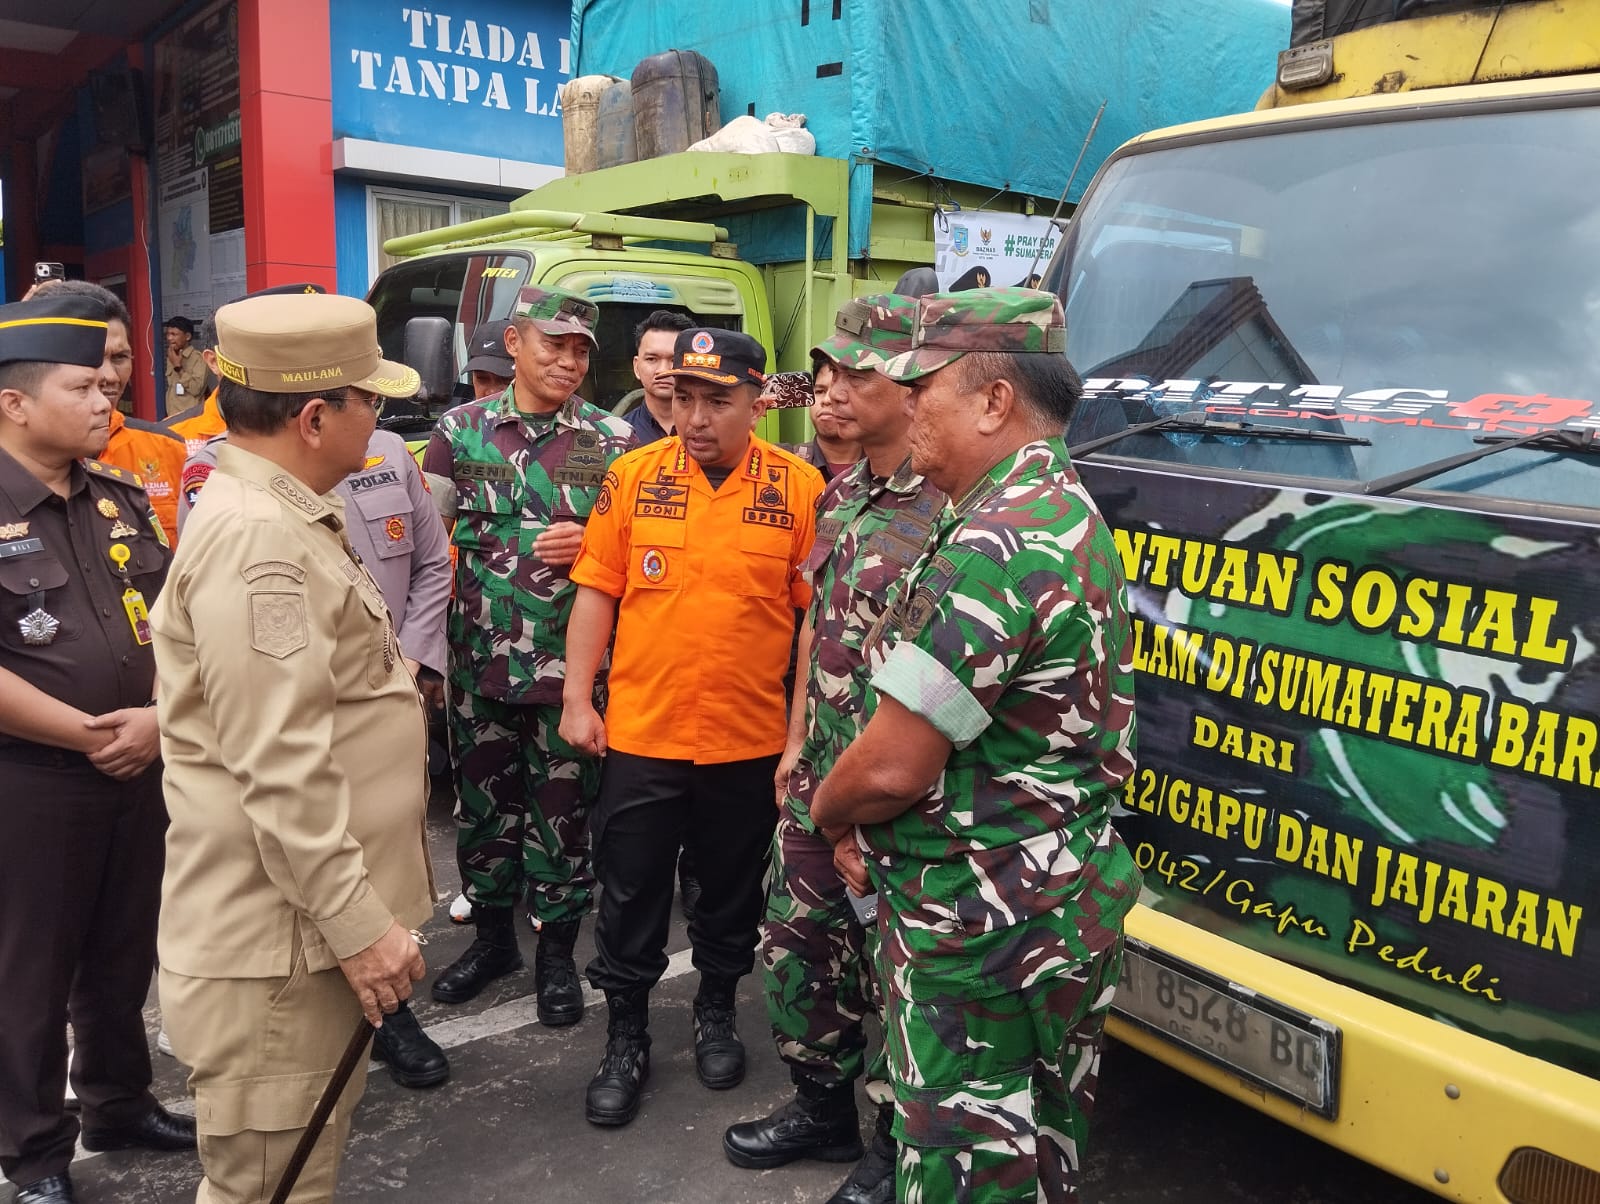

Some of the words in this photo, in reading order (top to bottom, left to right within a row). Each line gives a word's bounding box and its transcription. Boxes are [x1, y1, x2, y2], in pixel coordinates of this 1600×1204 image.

[402, 8, 545, 70] TIADA
[351, 48, 511, 110] TANPA
[1017, 235, 1038, 247] PRAY
[281, 366, 343, 383] MAULANA
[348, 470, 399, 492] POLRI
[462, 465, 507, 478] BENI
[559, 471, 584, 482] TNI
[643, 504, 678, 517] DONI
[748, 511, 789, 525] BPBD
[1114, 528, 1299, 611] NTUAN
[1311, 563, 1569, 665] SOSIAL
[1132, 619, 1204, 685] LAM
[1208, 638, 1252, 698] DI
[1254, 649, 1484, 758] SUMATERA
[1490, 701, 1600, 789] BAR
[1193, 716, 1295, 772] DARI
[1275, 814, 1364, 886] DAN
[1371, 846, 1583, 957] JAJARAN
[1135, 842, 1327, 937] 042/Gapu
[1348, 918, 1503, 1002] Peduli
[1156, 967, 1249, 1043] 8548
